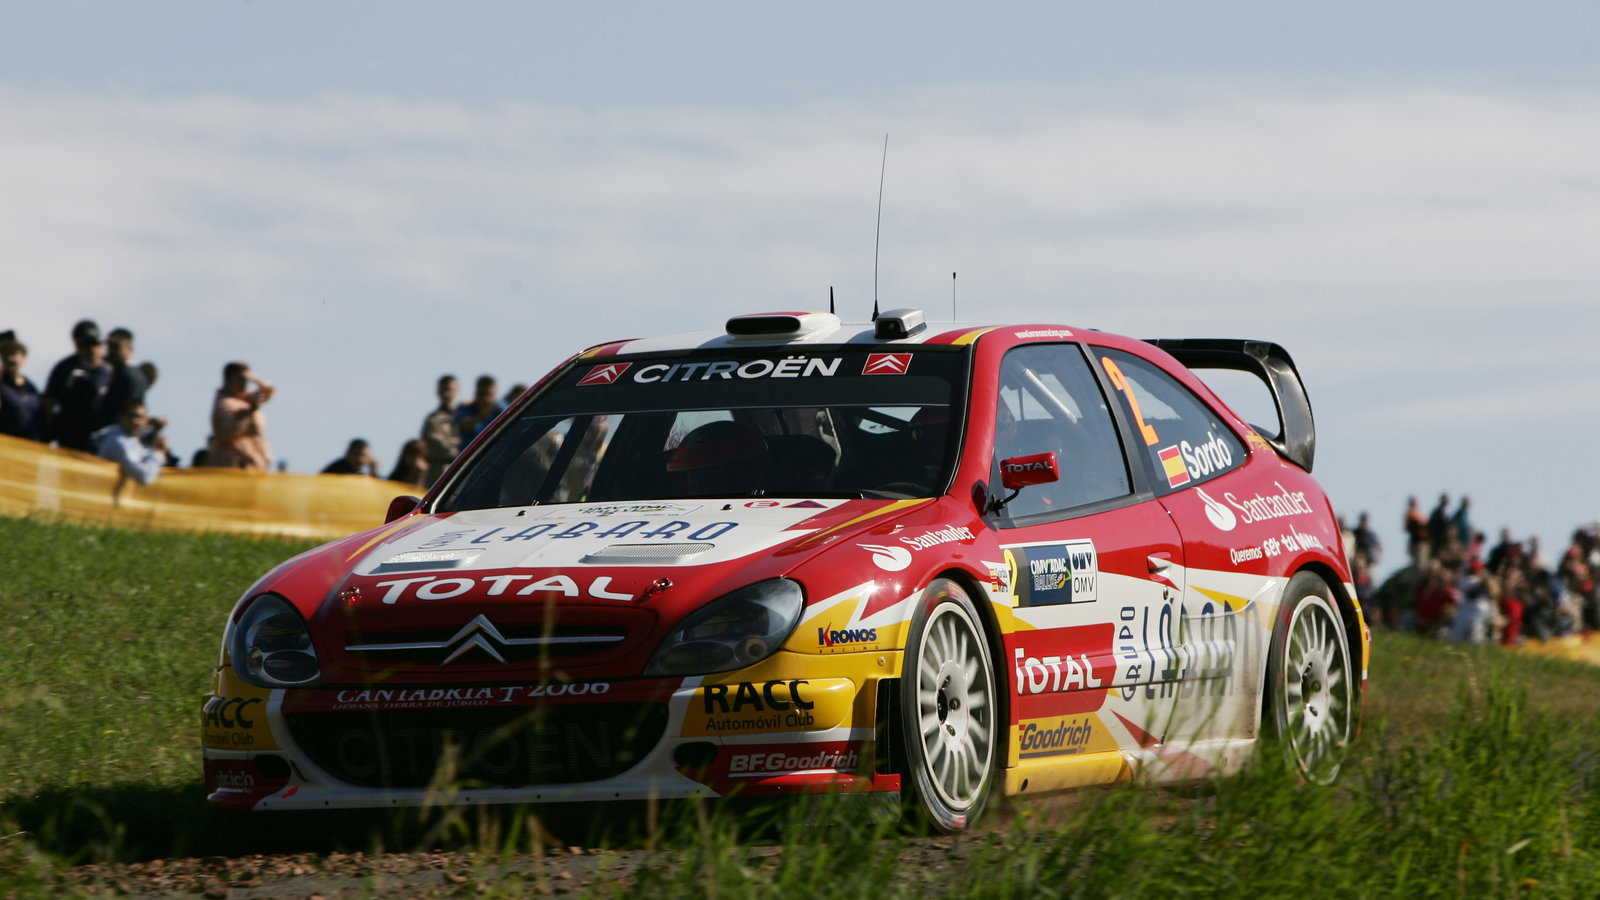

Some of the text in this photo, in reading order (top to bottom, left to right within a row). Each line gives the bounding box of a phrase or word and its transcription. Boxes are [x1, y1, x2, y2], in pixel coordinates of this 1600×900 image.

[633, 356, 843, 383] CITROËN
[1102, 356, 1160, 446] 2
[1005, 461, 1053, 473] TOTAL
[1180, 431, 1233, 480] Sordo
[1223, 480, 1314, 525] Santander
[899, 524, 976, 551] Santander
[1230, 547, 1263, 566] Queremos
[376, 574, 635, 605] TOTAL
[1004, 549, 1019, 607] 2
[1073, 577, 1094, 593] OMV
[818, 621, 877, 648] KRONOS
[1119, 606, 1142, 702] GRUPO
[1015, 647, 1102, 695] TOTAL
[704, 680, 815, 714] RACC
[203, 697, 263, 729] ACC
[706, 711, 815, 731] Automóvil Club
